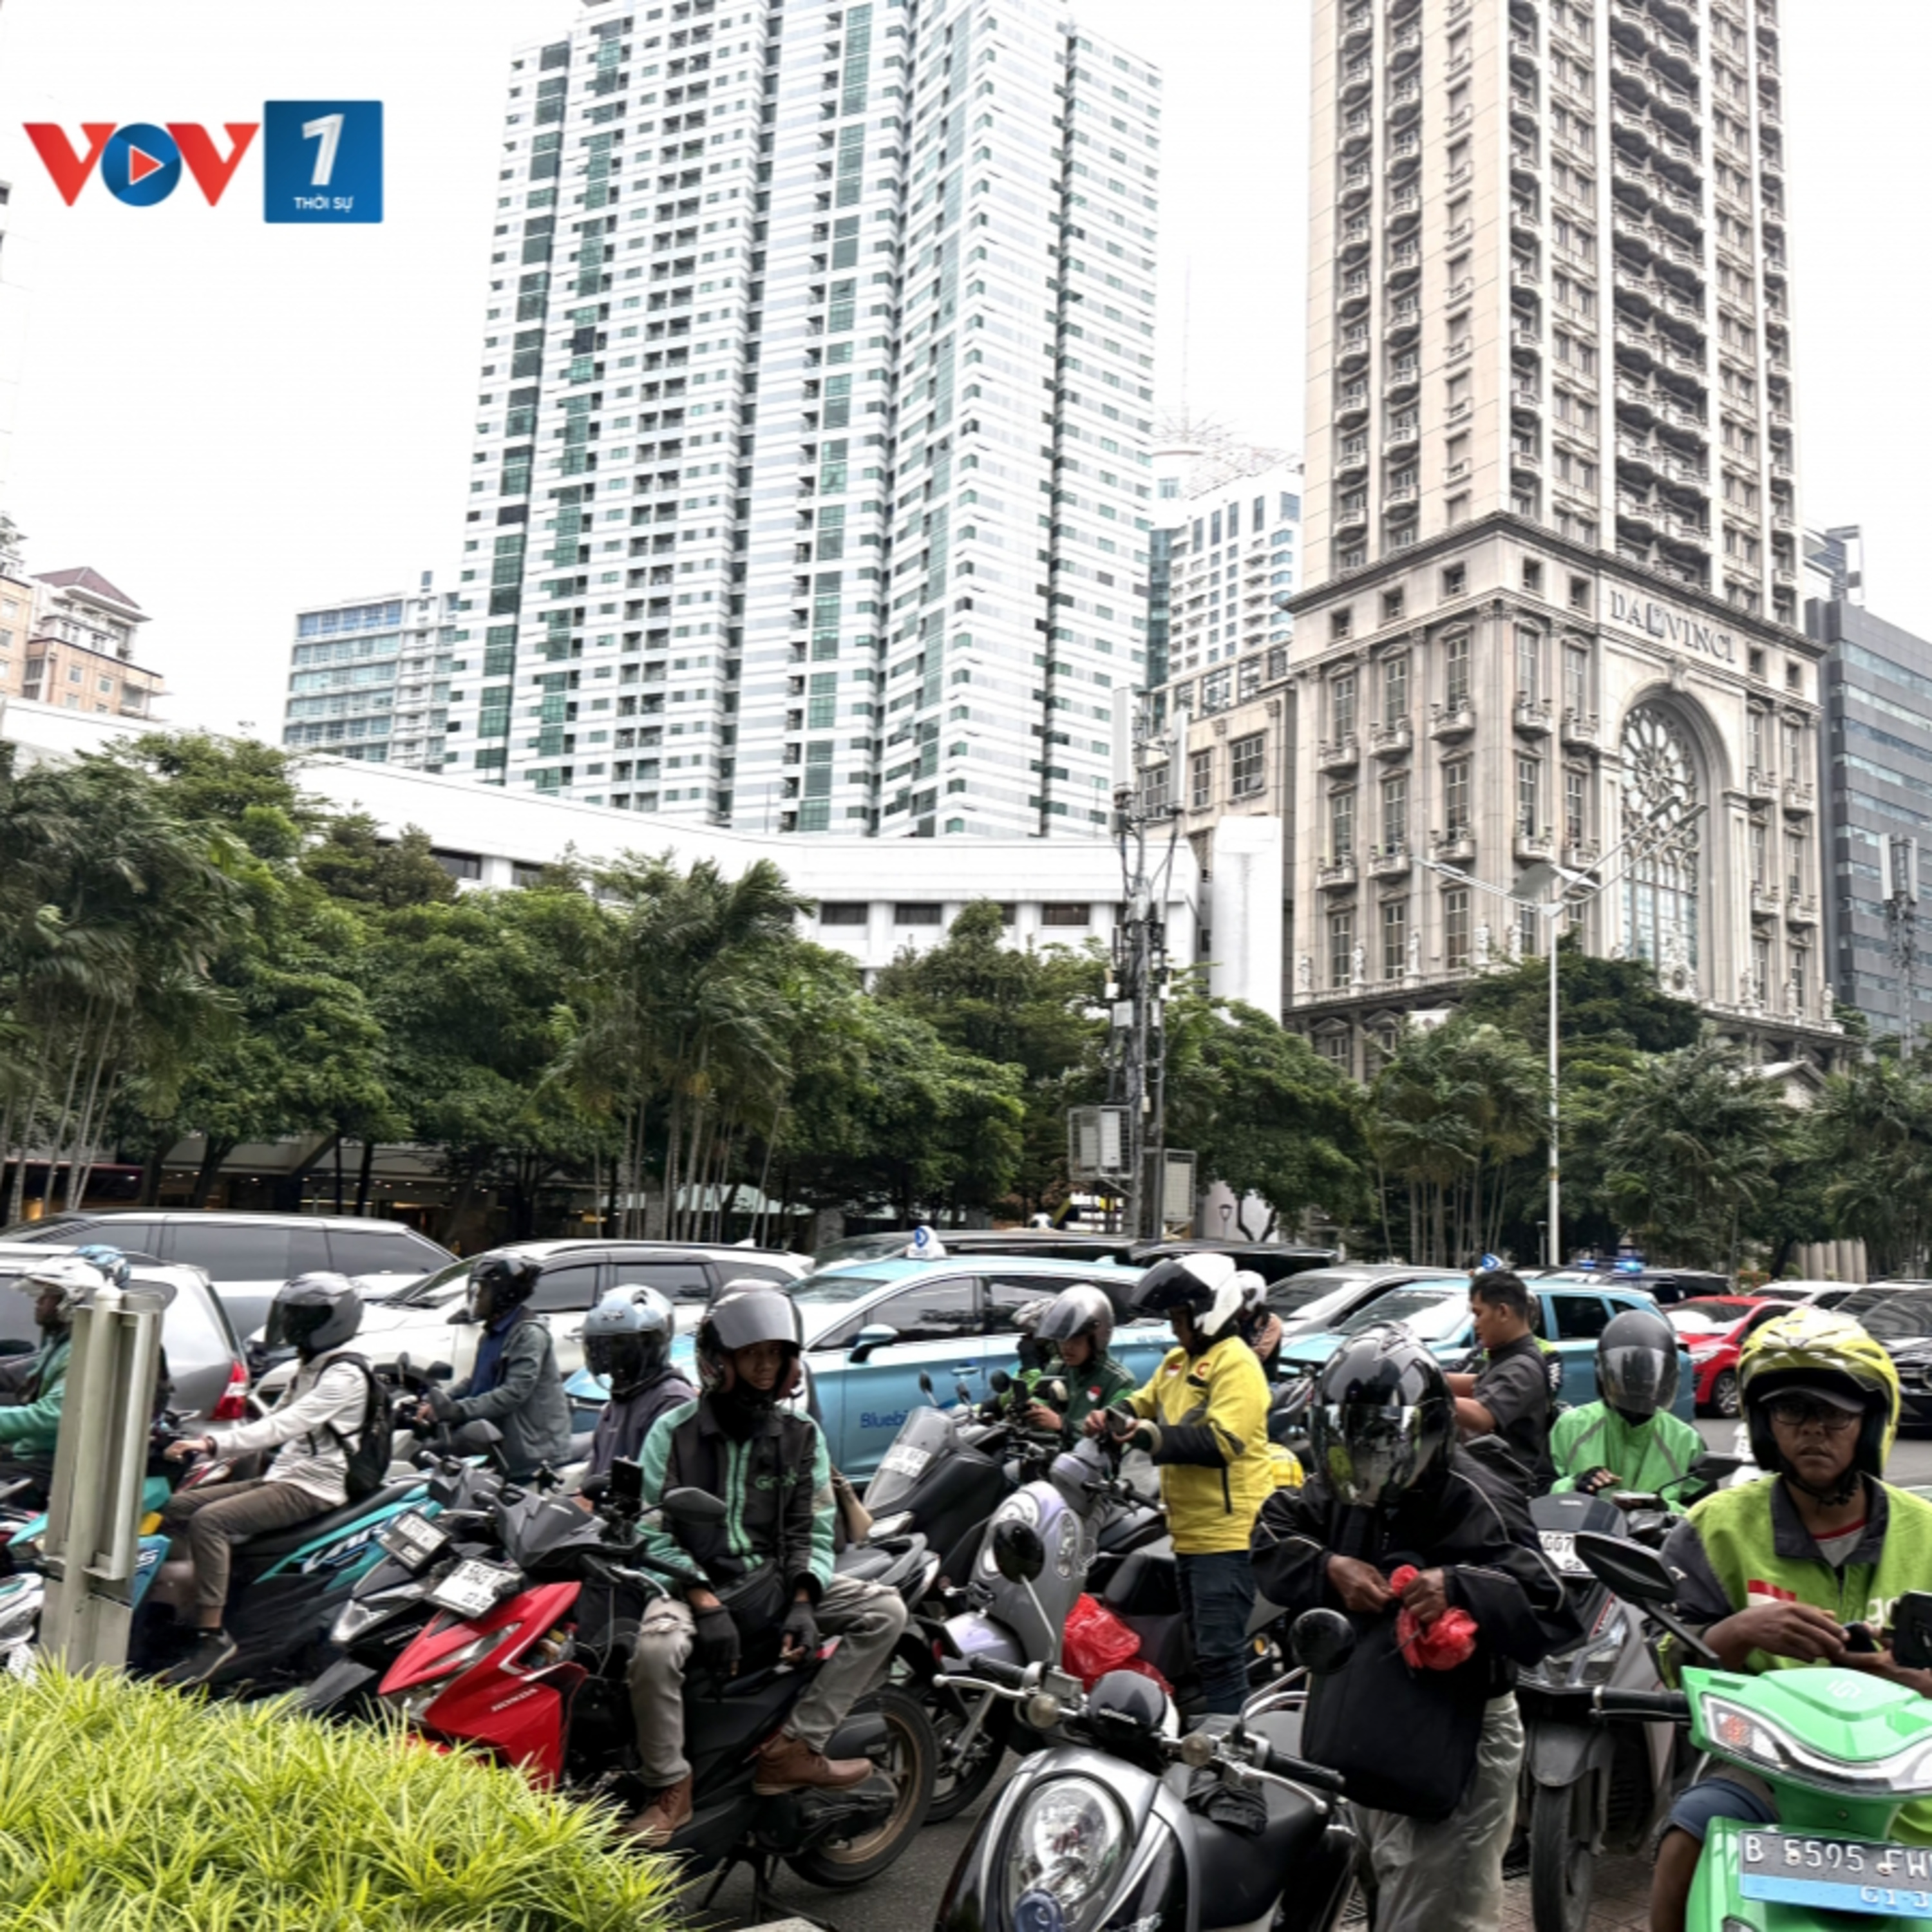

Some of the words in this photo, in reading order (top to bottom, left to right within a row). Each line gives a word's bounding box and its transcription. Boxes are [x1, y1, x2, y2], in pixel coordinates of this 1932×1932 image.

[1665, 612, 1735, 664] VINCI
[860, 1409, 908, 1428] Bluebi
[1745, 1835, 1765, 1862] B
